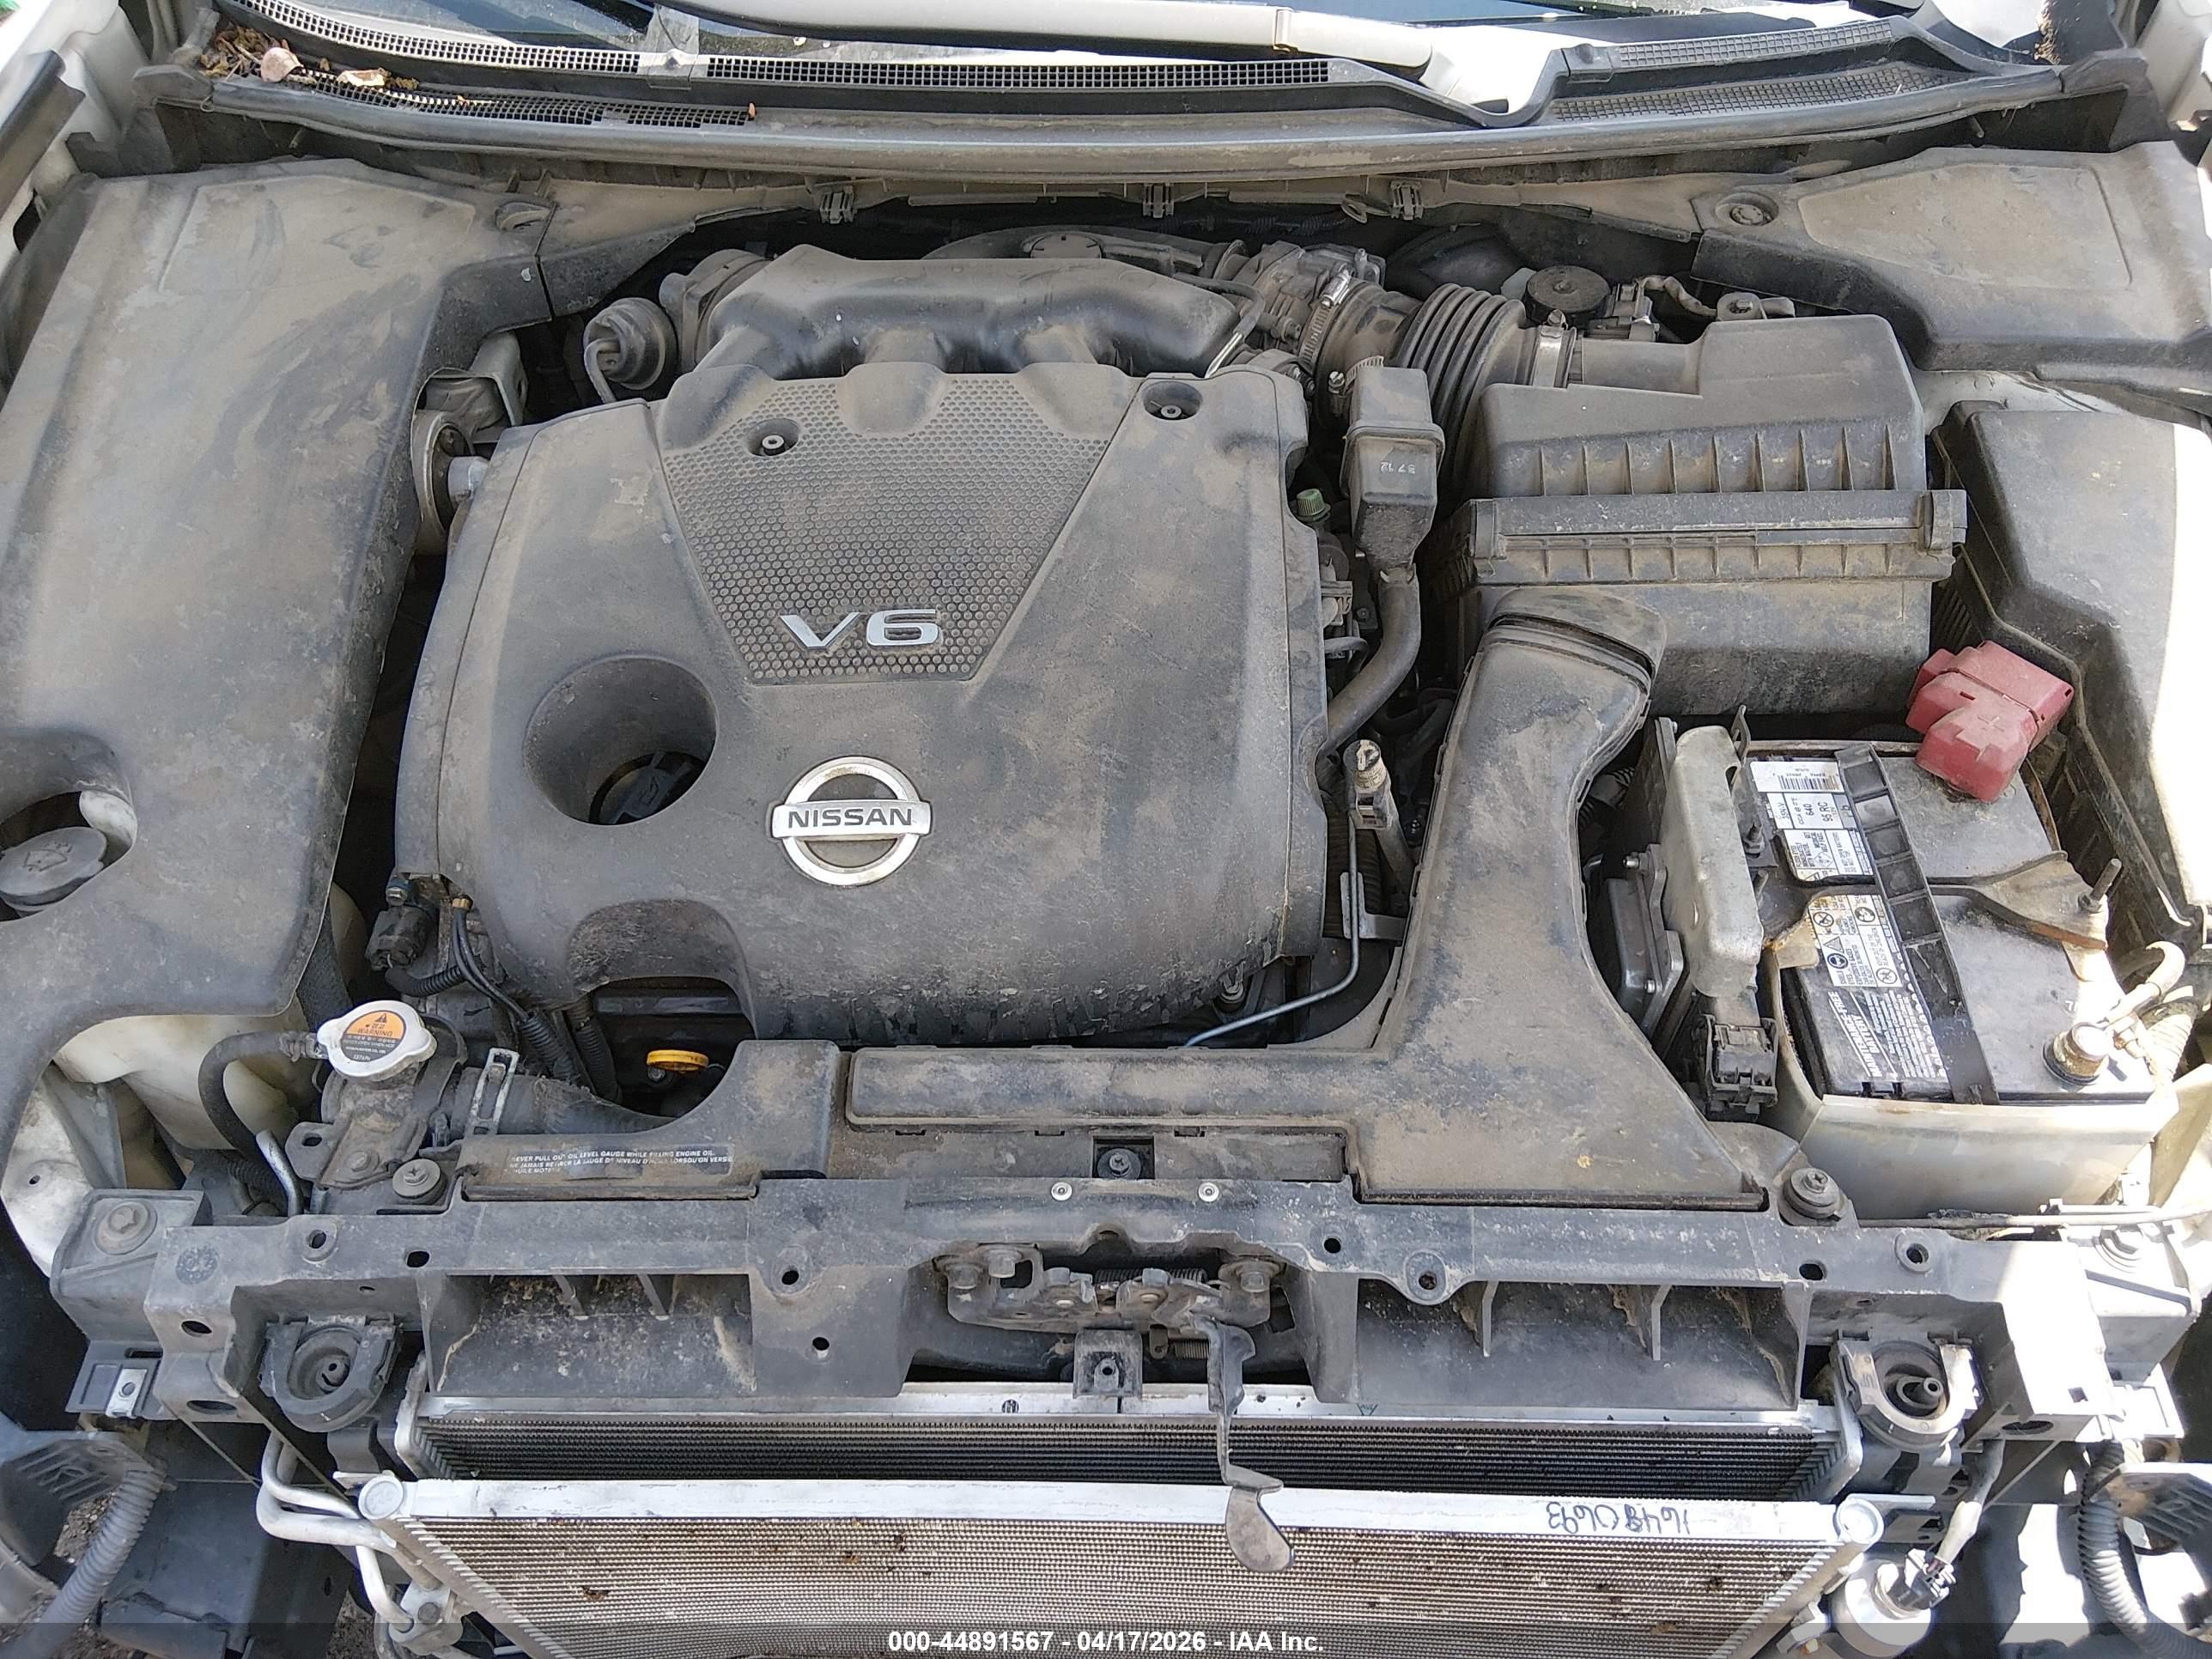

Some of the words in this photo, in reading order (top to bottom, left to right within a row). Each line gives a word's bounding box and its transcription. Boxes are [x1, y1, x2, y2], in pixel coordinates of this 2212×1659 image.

[780, 608, 941, 648] V6
[1803, 804, 1814, 816] 640
[1818, 802, 1831, 811] RC
[788, 808, 913, 828] NISSAN
[358, 1027, 393, 1036] WARNING
[1851, 1014, 1881, 1054] BATTERY
